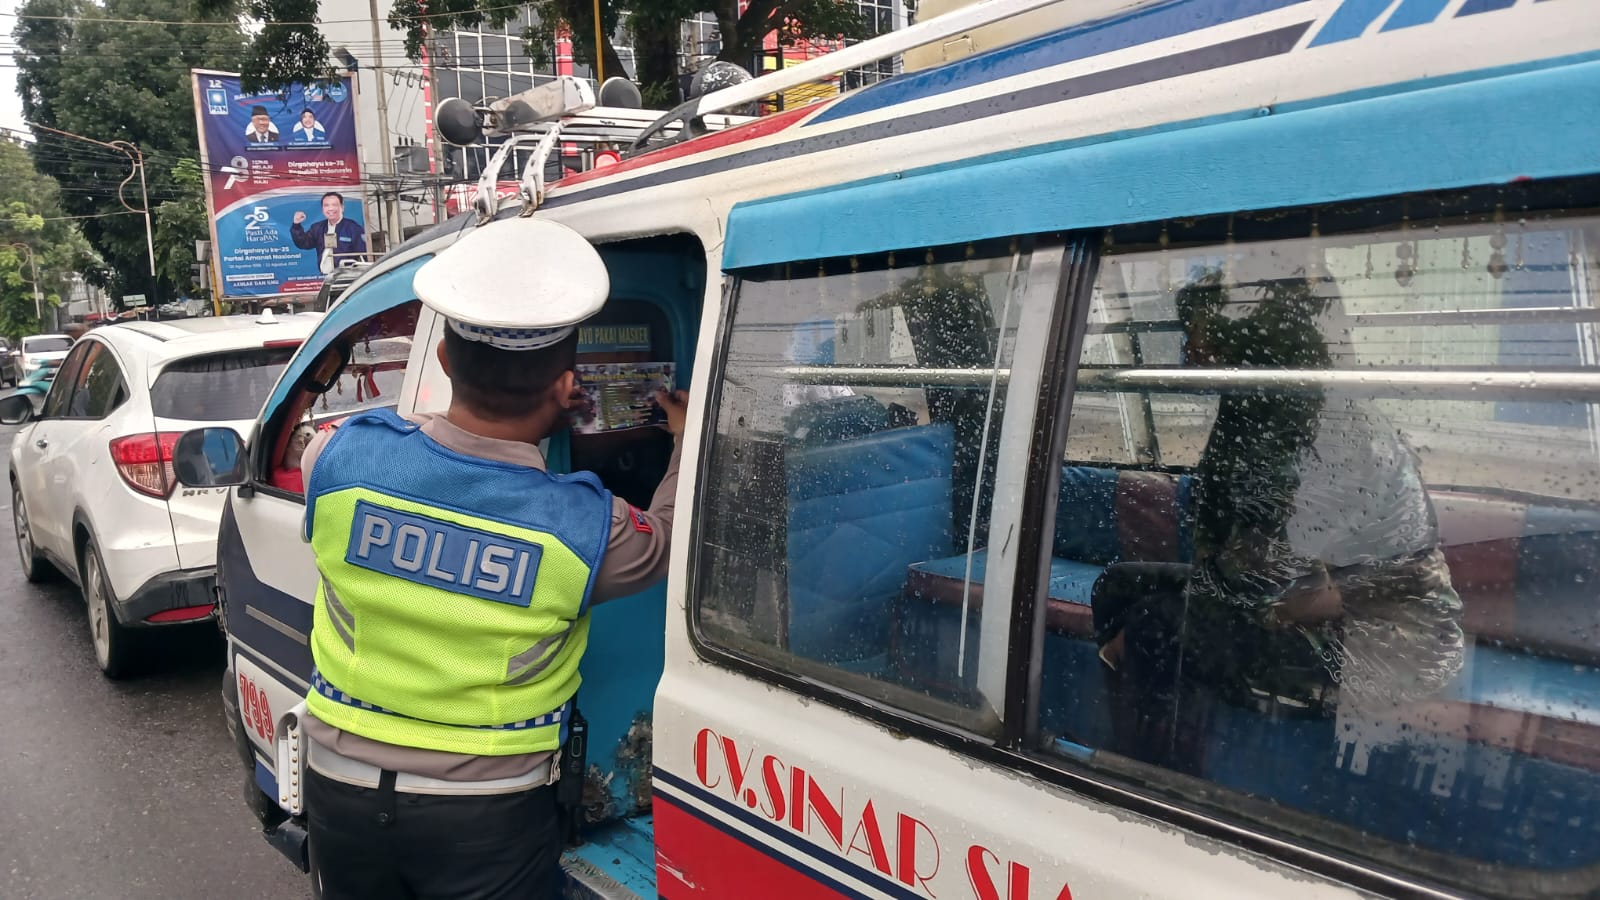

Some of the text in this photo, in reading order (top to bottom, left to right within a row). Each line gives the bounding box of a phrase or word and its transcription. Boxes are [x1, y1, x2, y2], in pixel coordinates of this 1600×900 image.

[209, 80, 222, 88] 12
[244, 206, 269, 230] 25
[234, 247, 269, 255] Dirgahayu
[578, 327, 649, 345] AYO PAKAI MASKER
[356, 514, 529, 597] POLISI
[239, 671, 274, 745] 799
[965, 844, 1073, 900] SI
